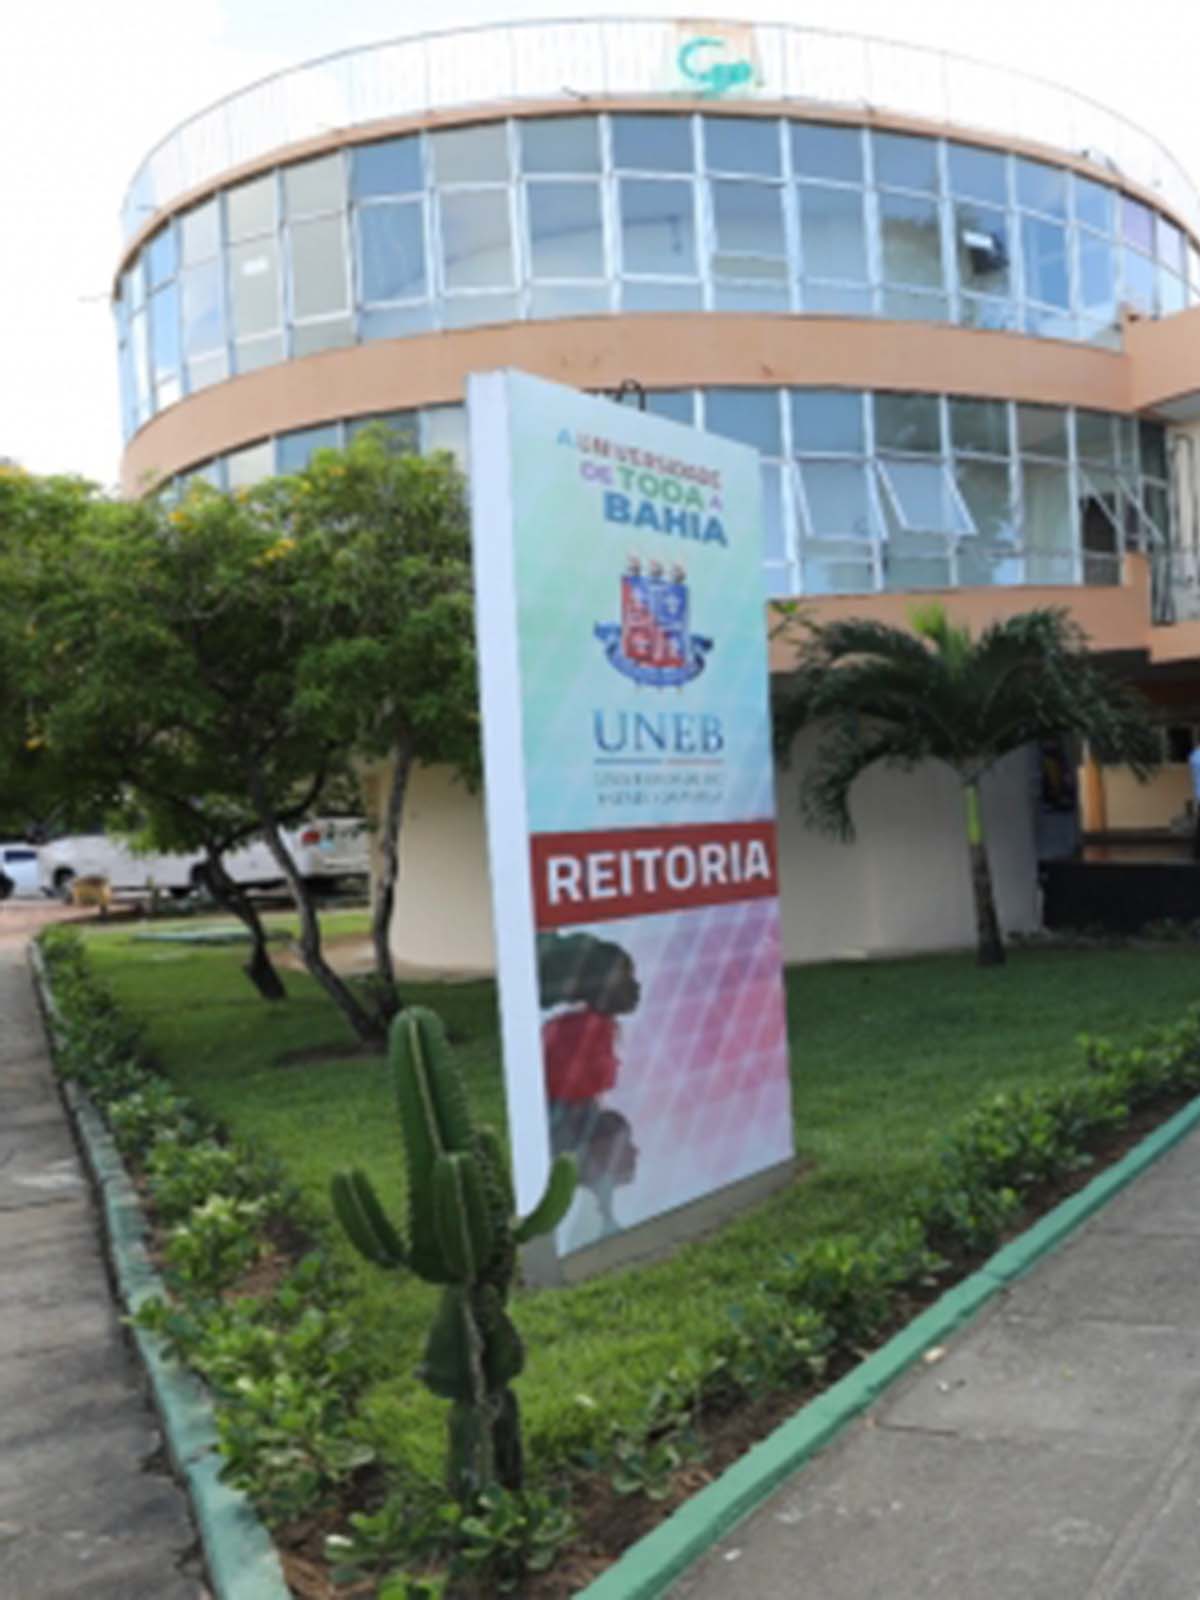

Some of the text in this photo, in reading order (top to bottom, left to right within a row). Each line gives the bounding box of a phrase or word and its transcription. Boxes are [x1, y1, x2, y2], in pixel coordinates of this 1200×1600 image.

[556, 427, 573, 449] A
[616, 464, 704, 509] TODA
[603, 490, 729, 549] BAHIA
[593, 709, 726, 753] UNEB
[547, 840, 771, 905] REITORIA
